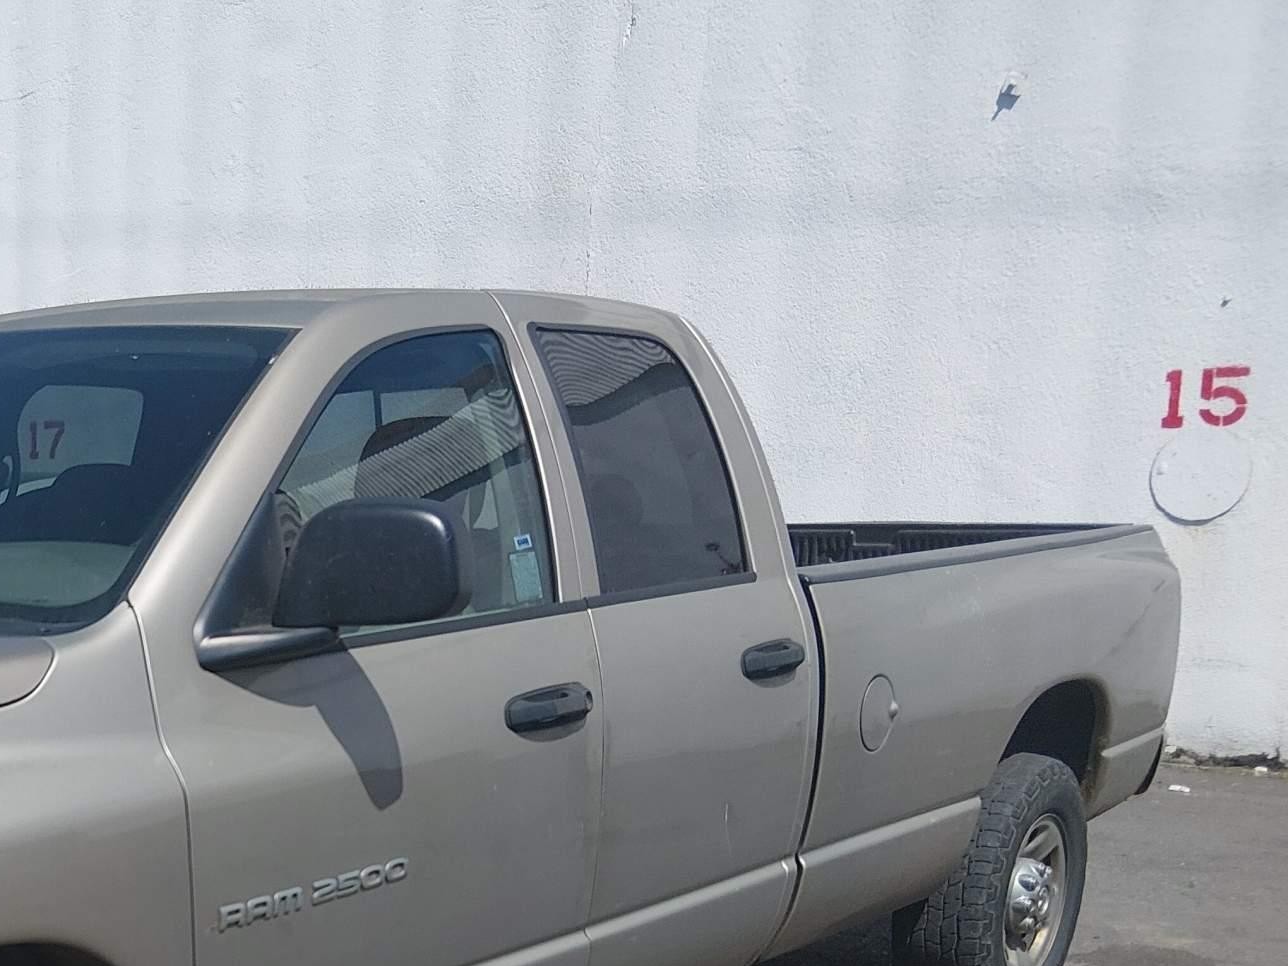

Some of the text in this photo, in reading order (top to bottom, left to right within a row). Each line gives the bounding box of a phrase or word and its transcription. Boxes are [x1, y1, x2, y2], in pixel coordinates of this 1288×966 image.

[1161, 366, 1251, 428] 15
[29, 420, 65, 460] 17
[218, 857, 410, 934] RAM 2500
